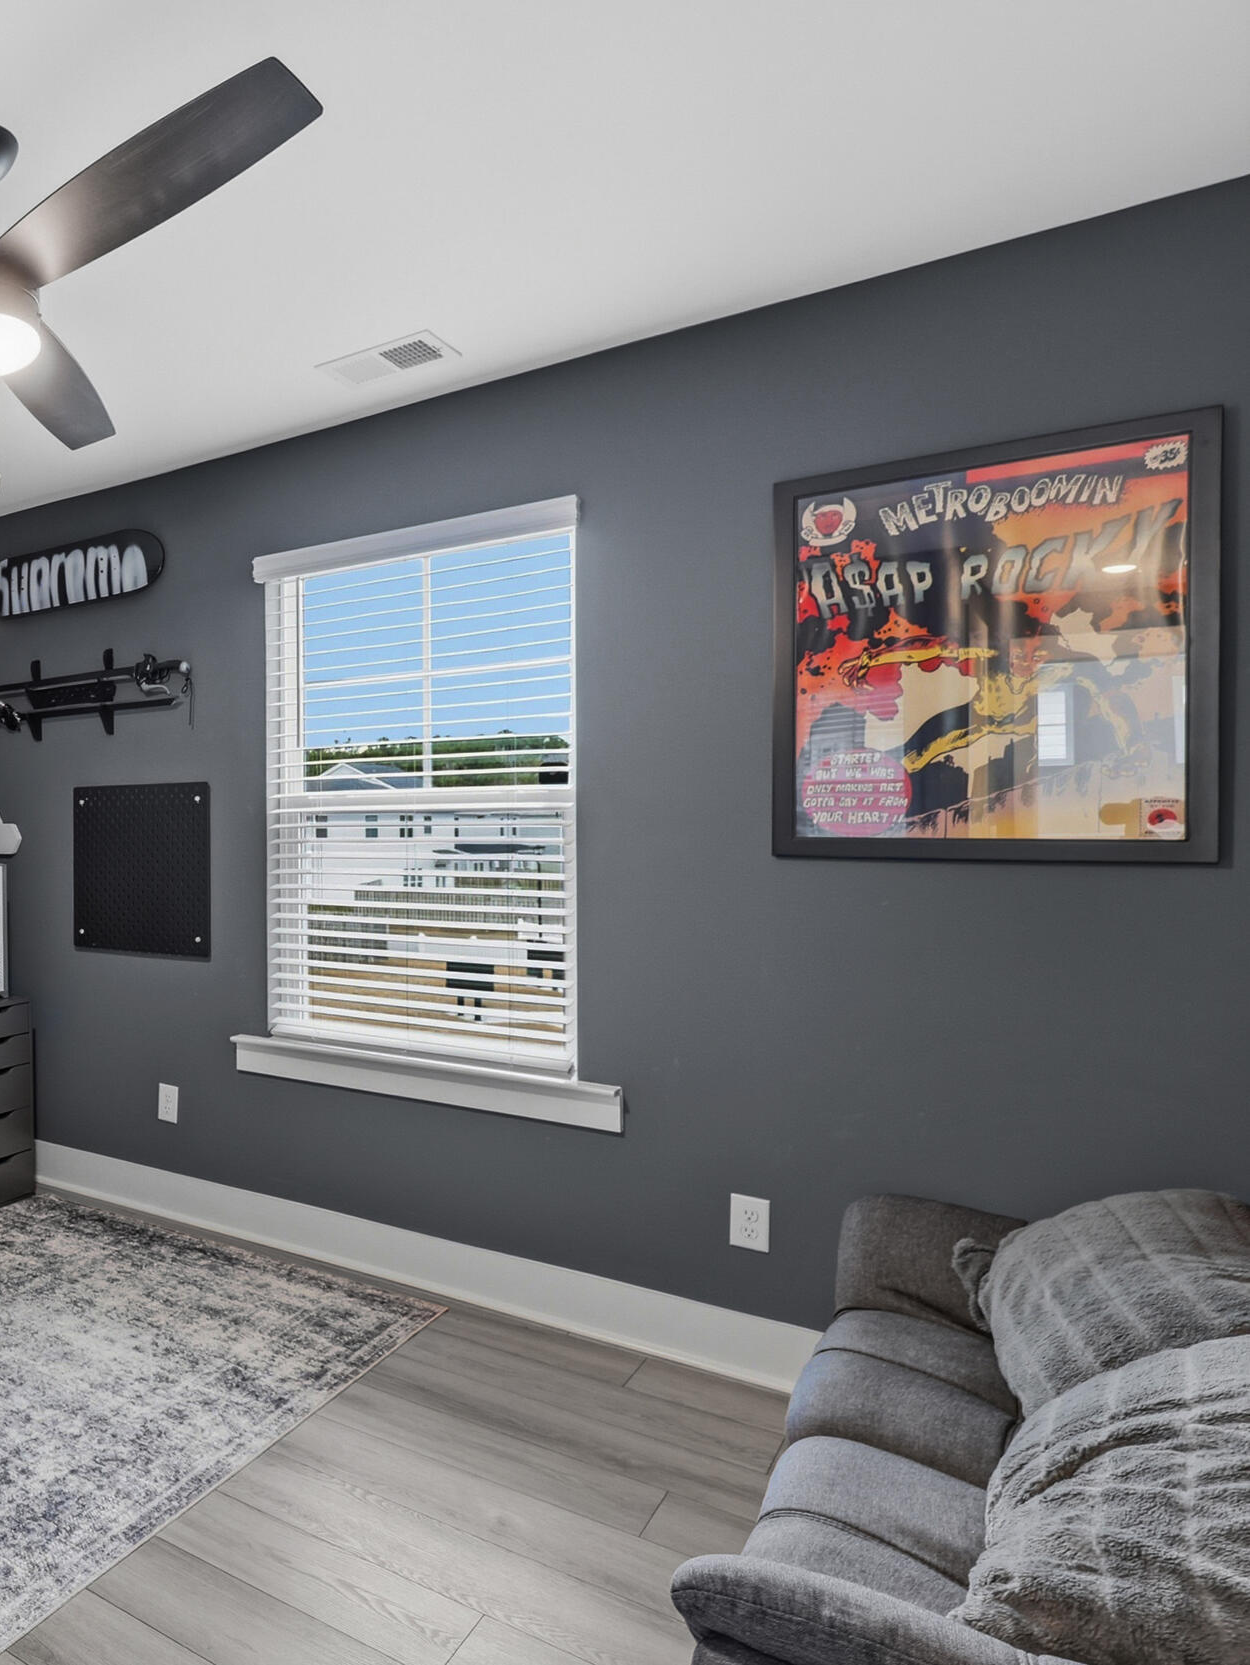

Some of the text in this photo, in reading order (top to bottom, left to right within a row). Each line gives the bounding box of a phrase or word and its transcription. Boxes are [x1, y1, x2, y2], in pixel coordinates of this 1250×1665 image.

[959, 498, 1181, 601] ROCKY
[815, 768, 838, 780] BUT
[870, 767, 894, 779] WAS
[806, 784, 833, 794] ONLY
[878, 796, 908, 807] FROM
[812, 811, 843, 824] YOUR
[848, 811, 889, 824] HEART
